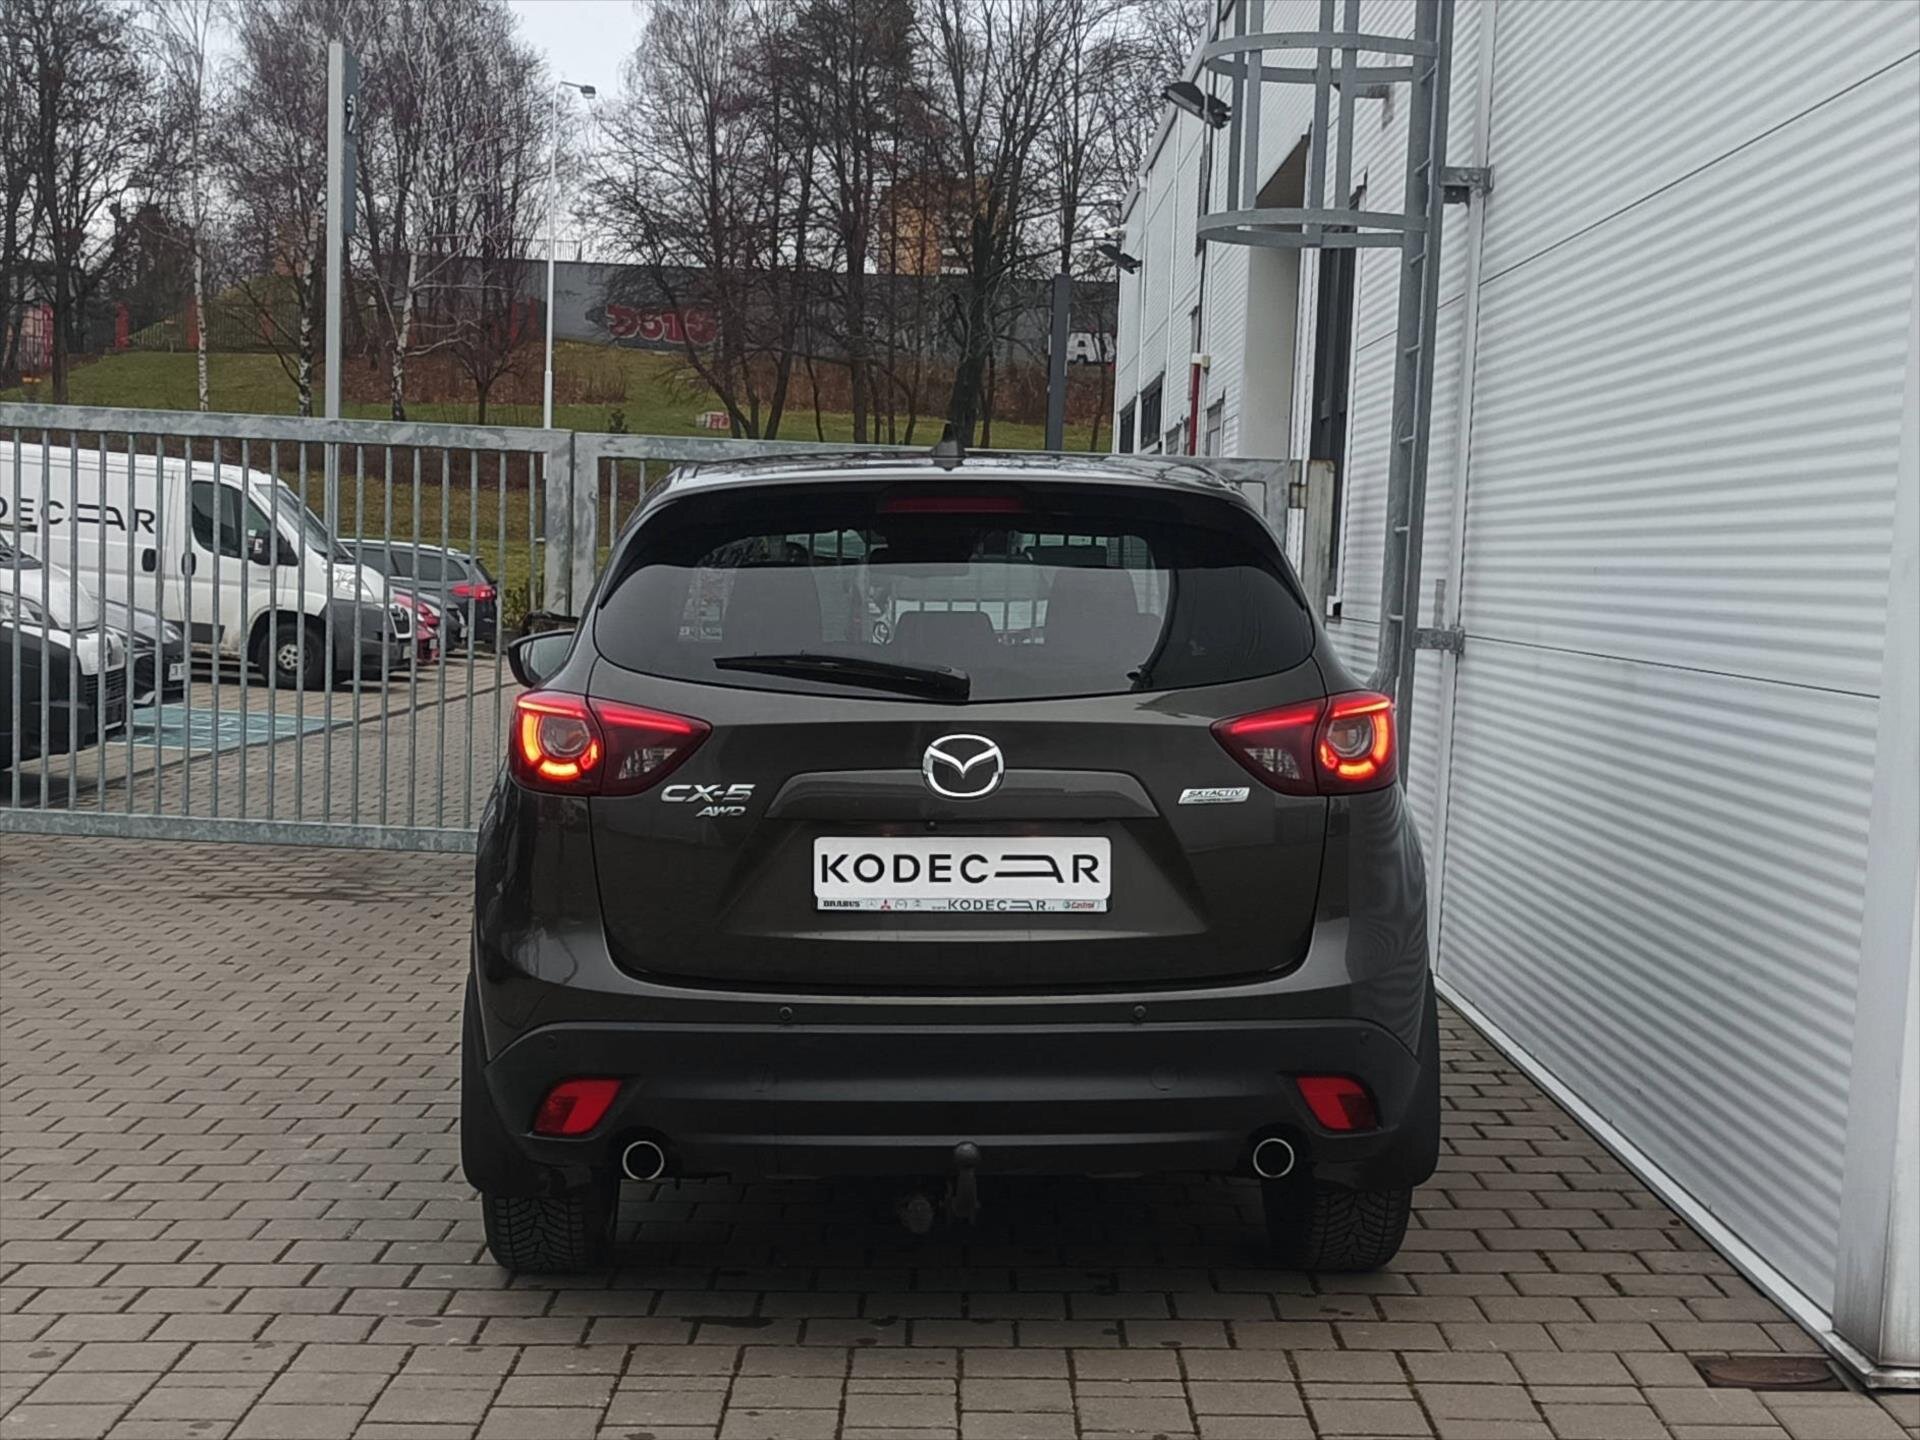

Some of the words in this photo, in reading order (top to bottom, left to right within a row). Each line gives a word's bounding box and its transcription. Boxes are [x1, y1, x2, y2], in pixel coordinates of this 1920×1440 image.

[661, 783, 756, 803] CX-5
[1186, 789, 1242, 798] SKYACTIV
[695, 806, 747, 817] AWD
[820, 853, 1101, 884] KODECAR
